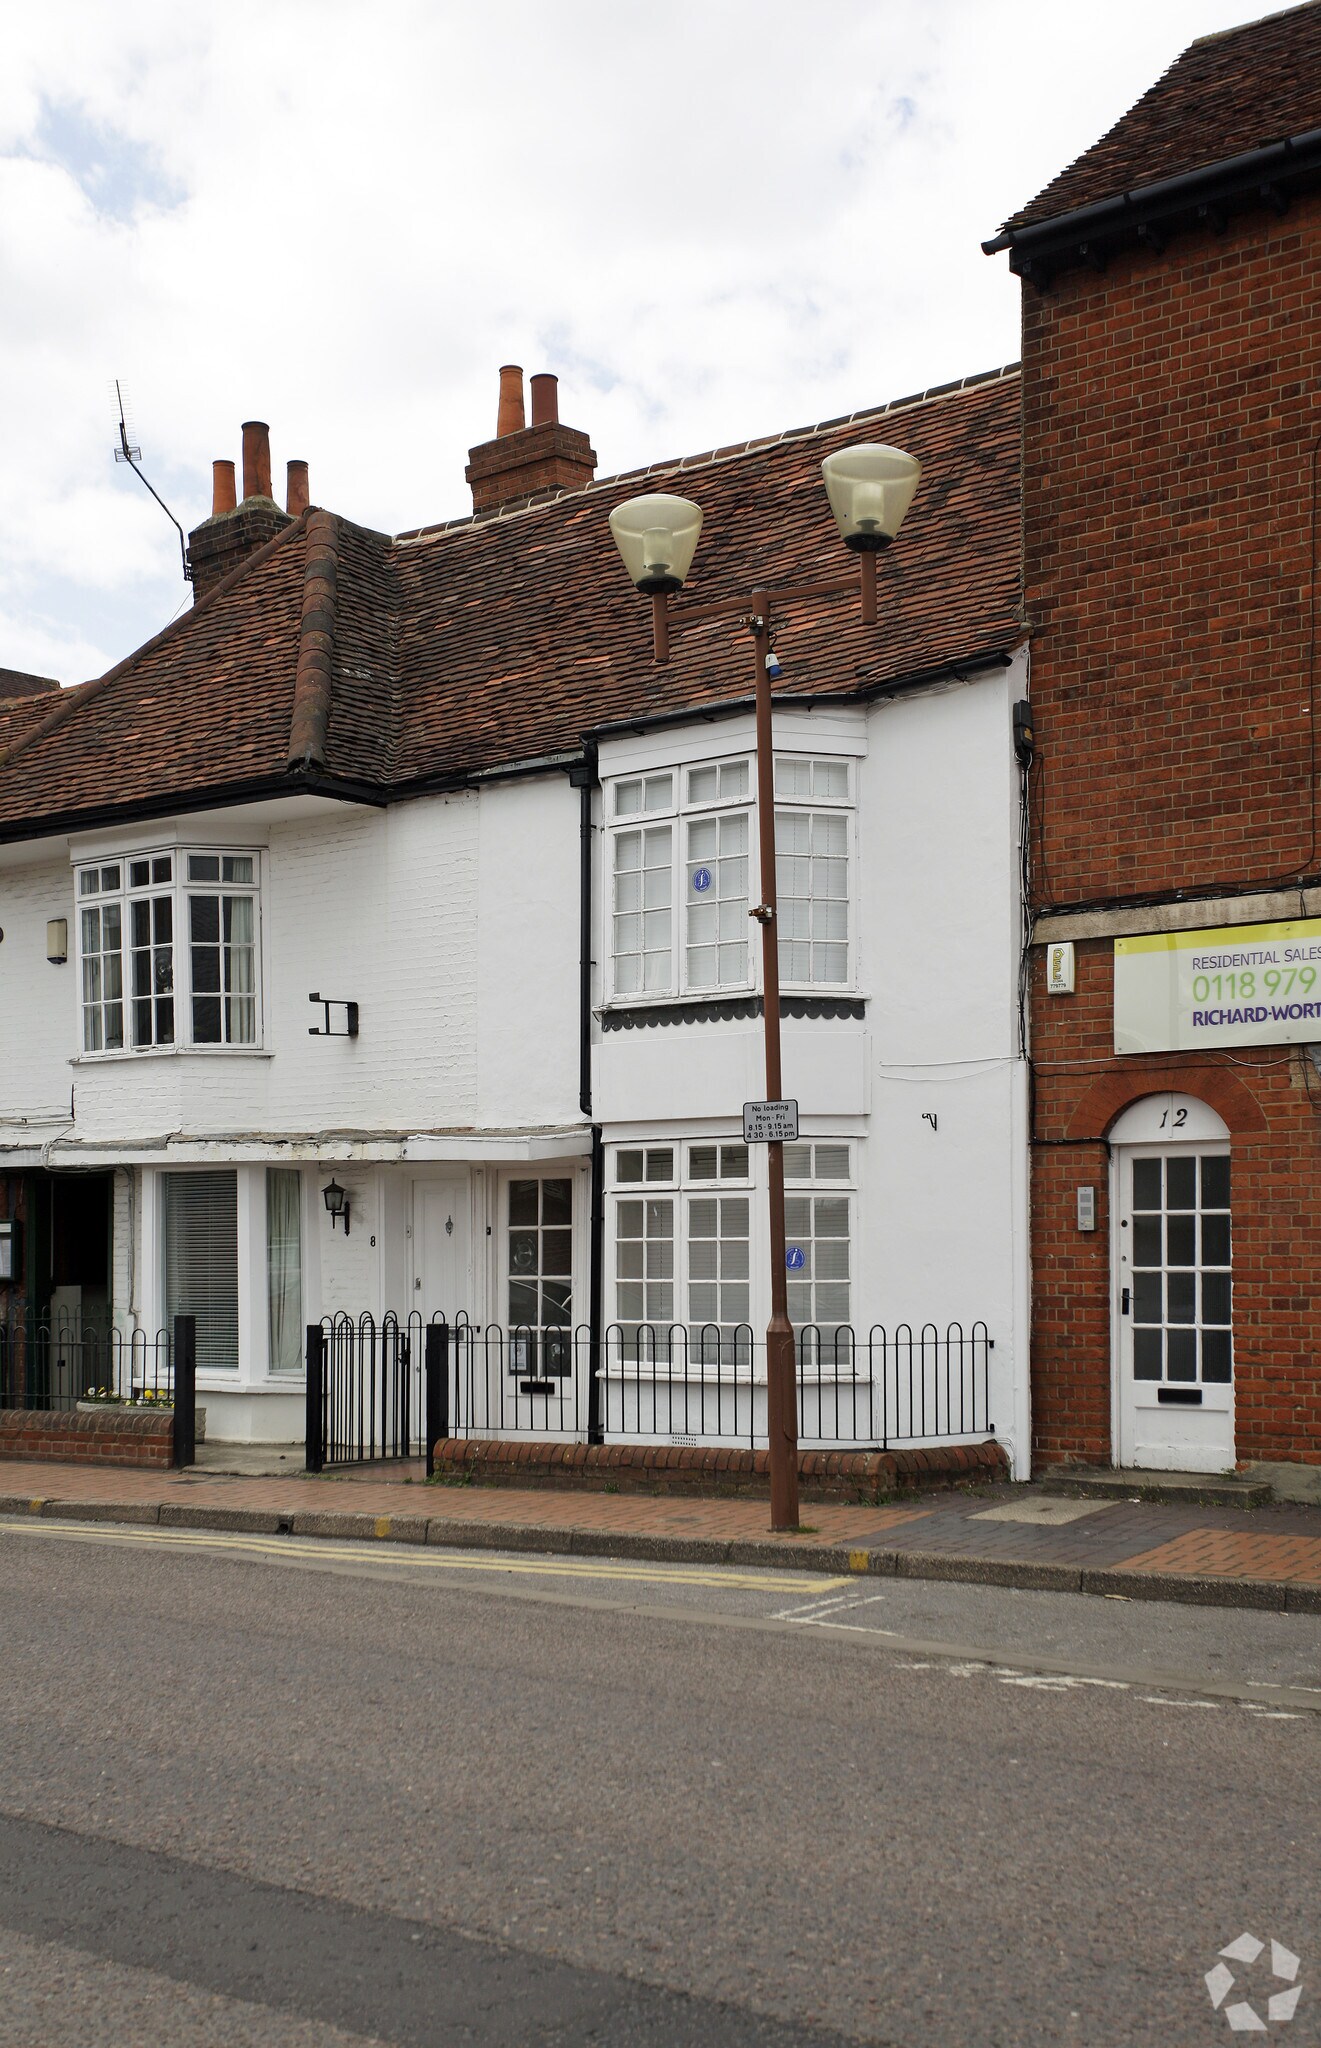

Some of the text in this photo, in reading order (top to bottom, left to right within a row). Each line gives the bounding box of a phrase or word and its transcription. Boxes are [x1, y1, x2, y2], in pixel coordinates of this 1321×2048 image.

[1192, 951, 1280, 970] RESIDENTIAL
[1192, 966, 1317, 1003] 0118 979
[1159, 1108, 1188, 1129] 12
[370, 1235, 376, 1248] 8
